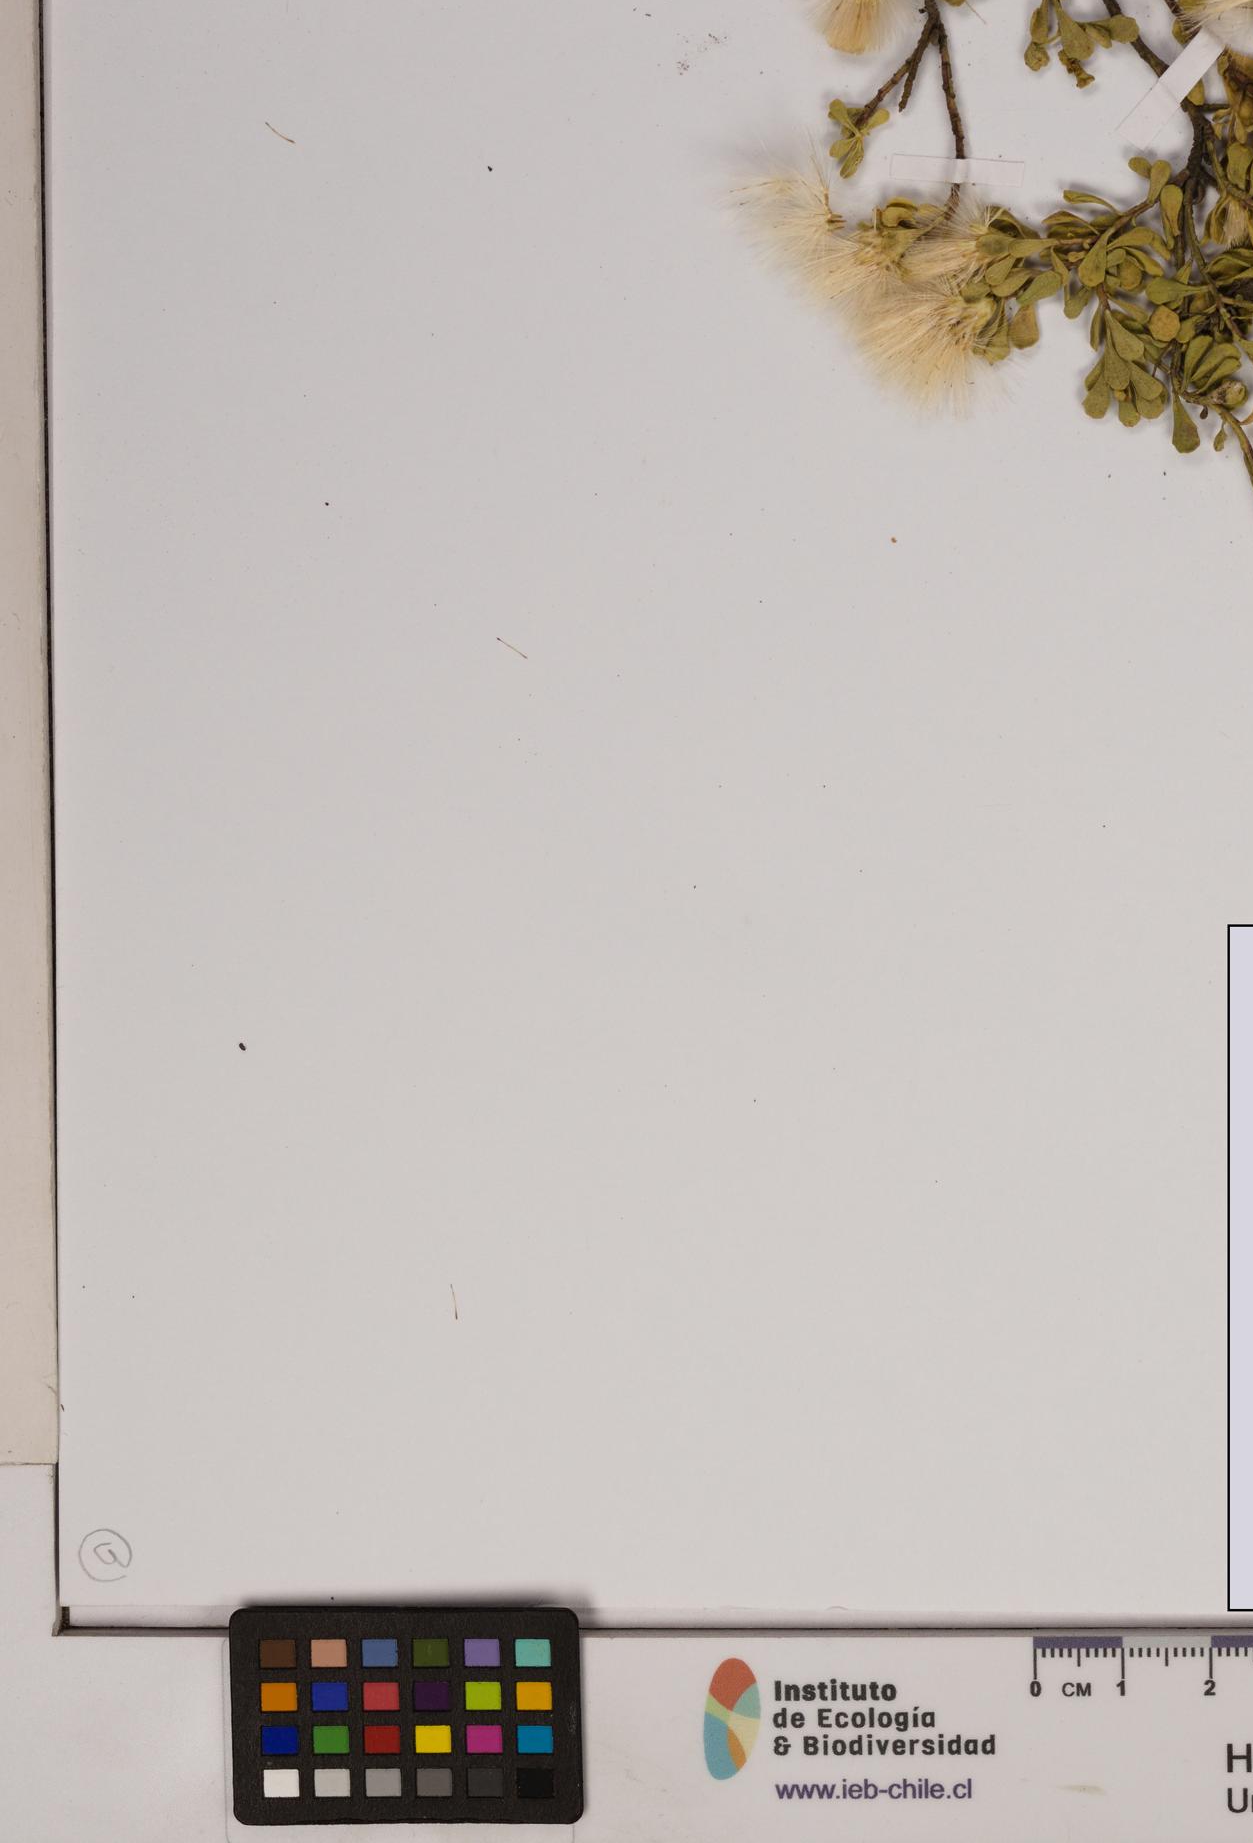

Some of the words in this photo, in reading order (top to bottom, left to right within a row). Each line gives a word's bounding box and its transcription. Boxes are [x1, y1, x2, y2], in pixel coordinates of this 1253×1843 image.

[773, 1677, 898, 1702] Instituto
[1029, 1680, 1043, 1698] 0
[1061, 1681, 1092, 1698] CM
[1115, 1680, 1126, 1697] 1
[1203, 1679, 1217, 1697] 2
[772, 1707, 806, 1730] de
[817, 1705, 936, 1734] Ecología
[773, 1735, 792, 1757] &
[802, 1733, 996, 1758] Biodiversidad
[774, 1777, 973, 1801] www.ieb-chile.cl
